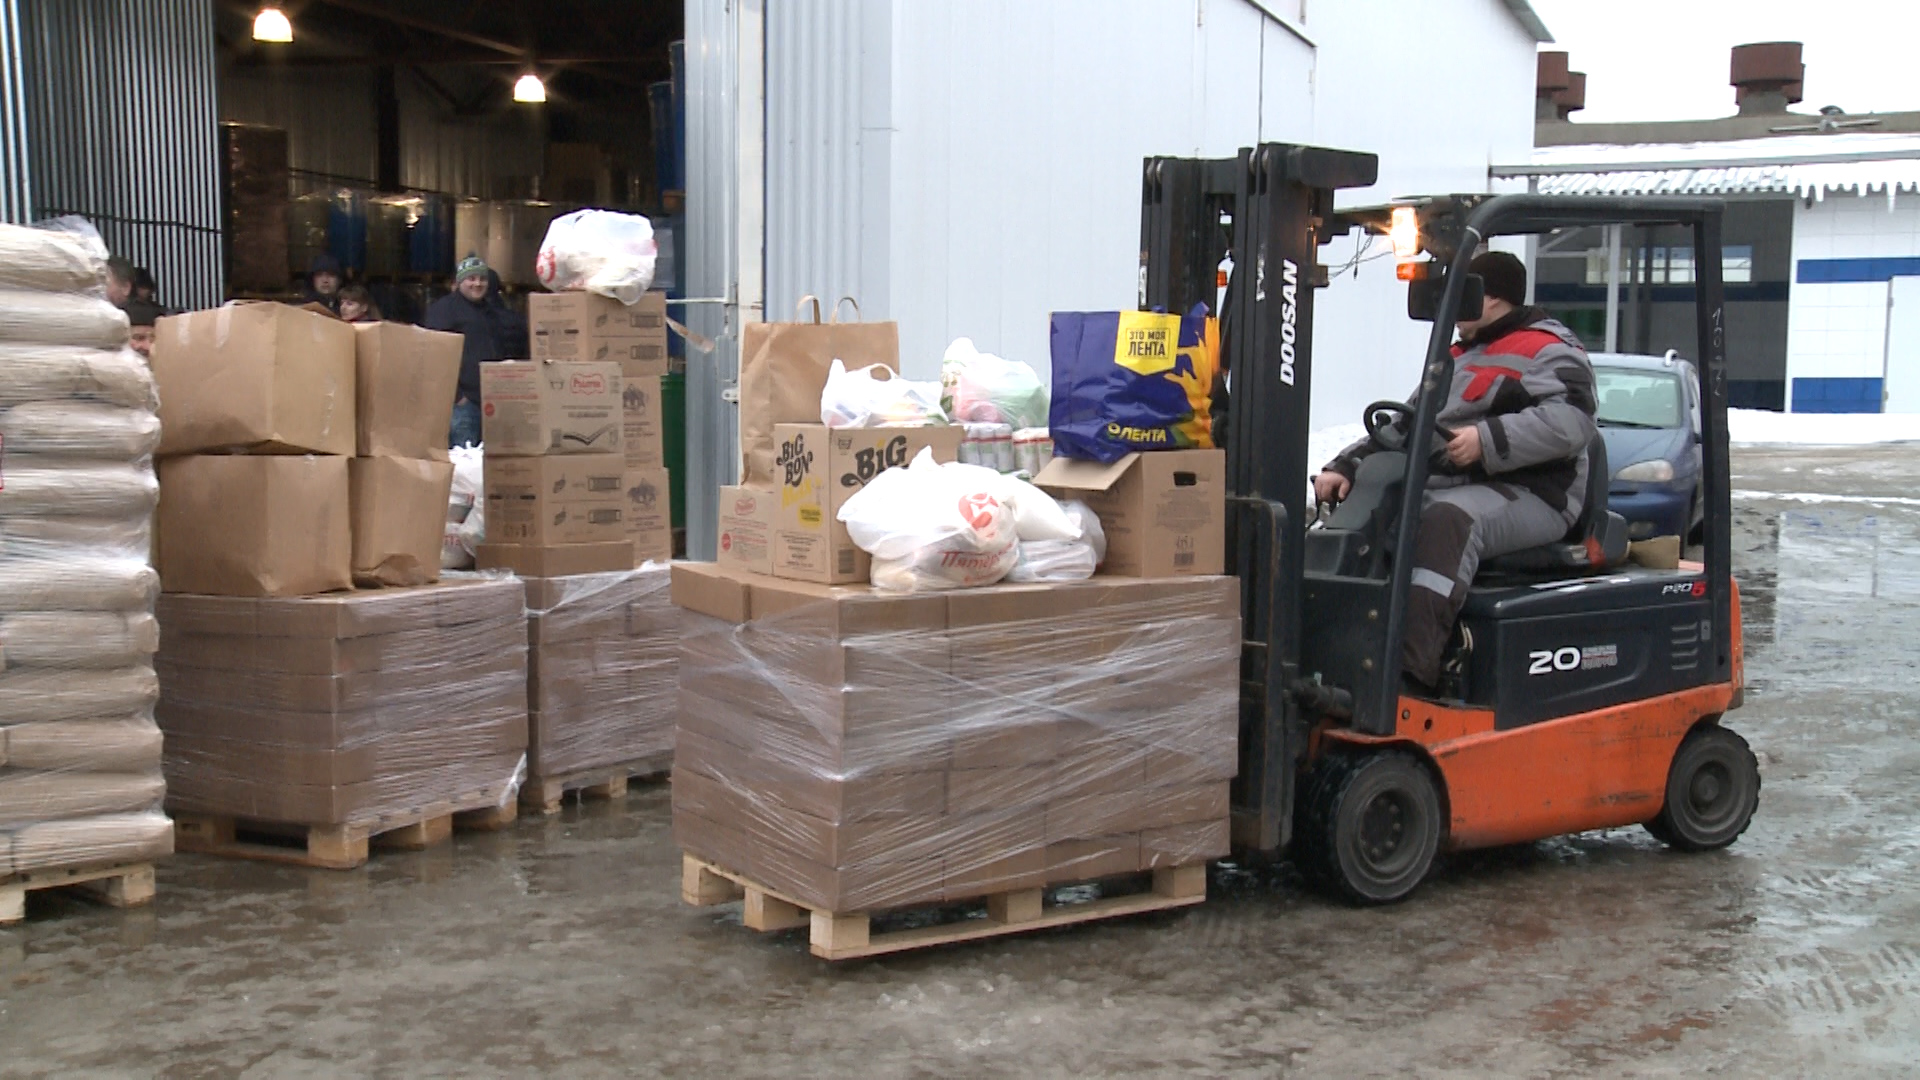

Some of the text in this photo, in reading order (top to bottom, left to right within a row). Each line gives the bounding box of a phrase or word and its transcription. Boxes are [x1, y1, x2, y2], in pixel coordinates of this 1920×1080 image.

[1280, 259, 1298, 386] DOOSAN
[1129, 331, 1166, 340] ЭТО МОЯ
[1127, 341, 1166, 356] ЛЕНТА
[1120, 426, 1167, 442] ЛЕНТА
[1529, 647, 1581, 675] 20
